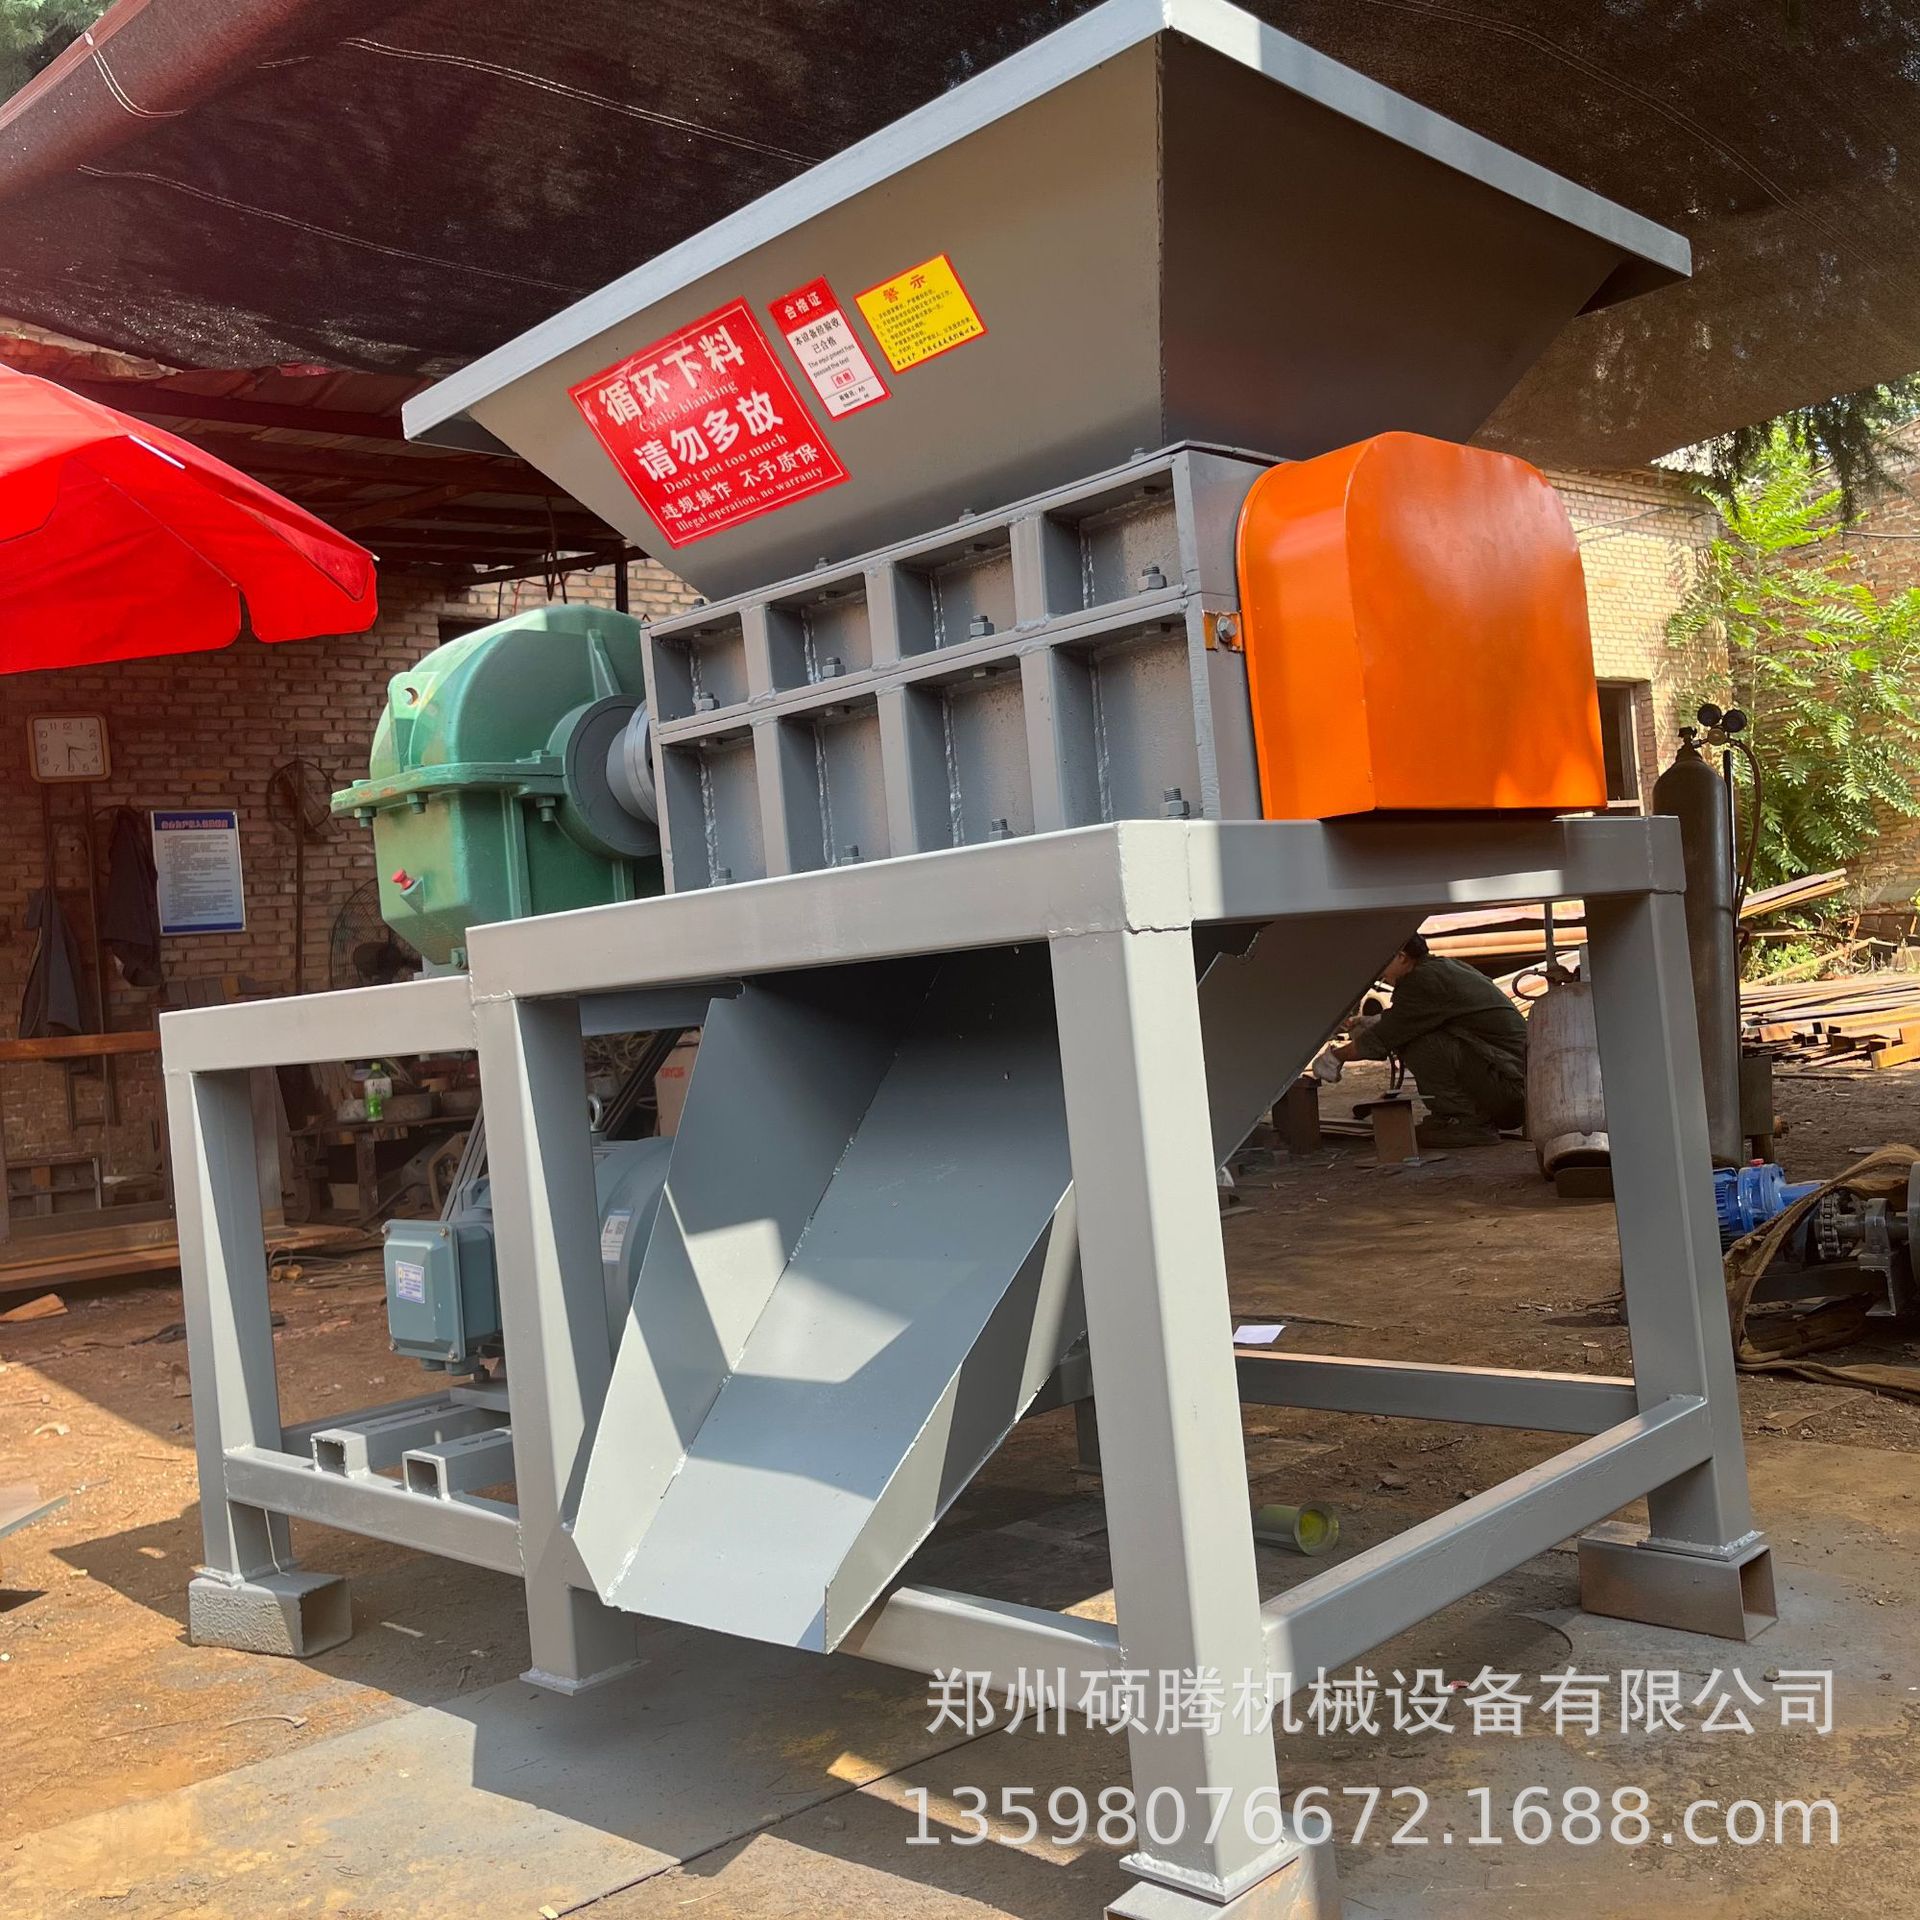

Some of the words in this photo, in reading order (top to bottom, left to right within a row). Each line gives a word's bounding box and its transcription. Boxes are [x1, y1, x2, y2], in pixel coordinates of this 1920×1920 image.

[784, 291, 822, 320] 合格证
[794, 317, 841, 346] 本设备经验收
[599, 325, 745, 426] 循环下料
[812, 336, 837, 354] 已合格
[633, 390, 783, 482] 请勿多放
[638, 409, 679, 433] Cyclic
[679, 380, 739, 413] blanking
[661, 481, 733, 521] 违规操作
[739, 443, 819, 489] 不予质保
[662, 471, 700, 495] Don't
[700, 465, 723, 482] put
[725, 453, 748, 469] too
[749, 433, 788, 458] much
[675, 513, 707, 532] Illegal
[708, 495, 760, 520] operation,
[760, 487, 774, 498] no
[775, 466, 823, 492] warranty
